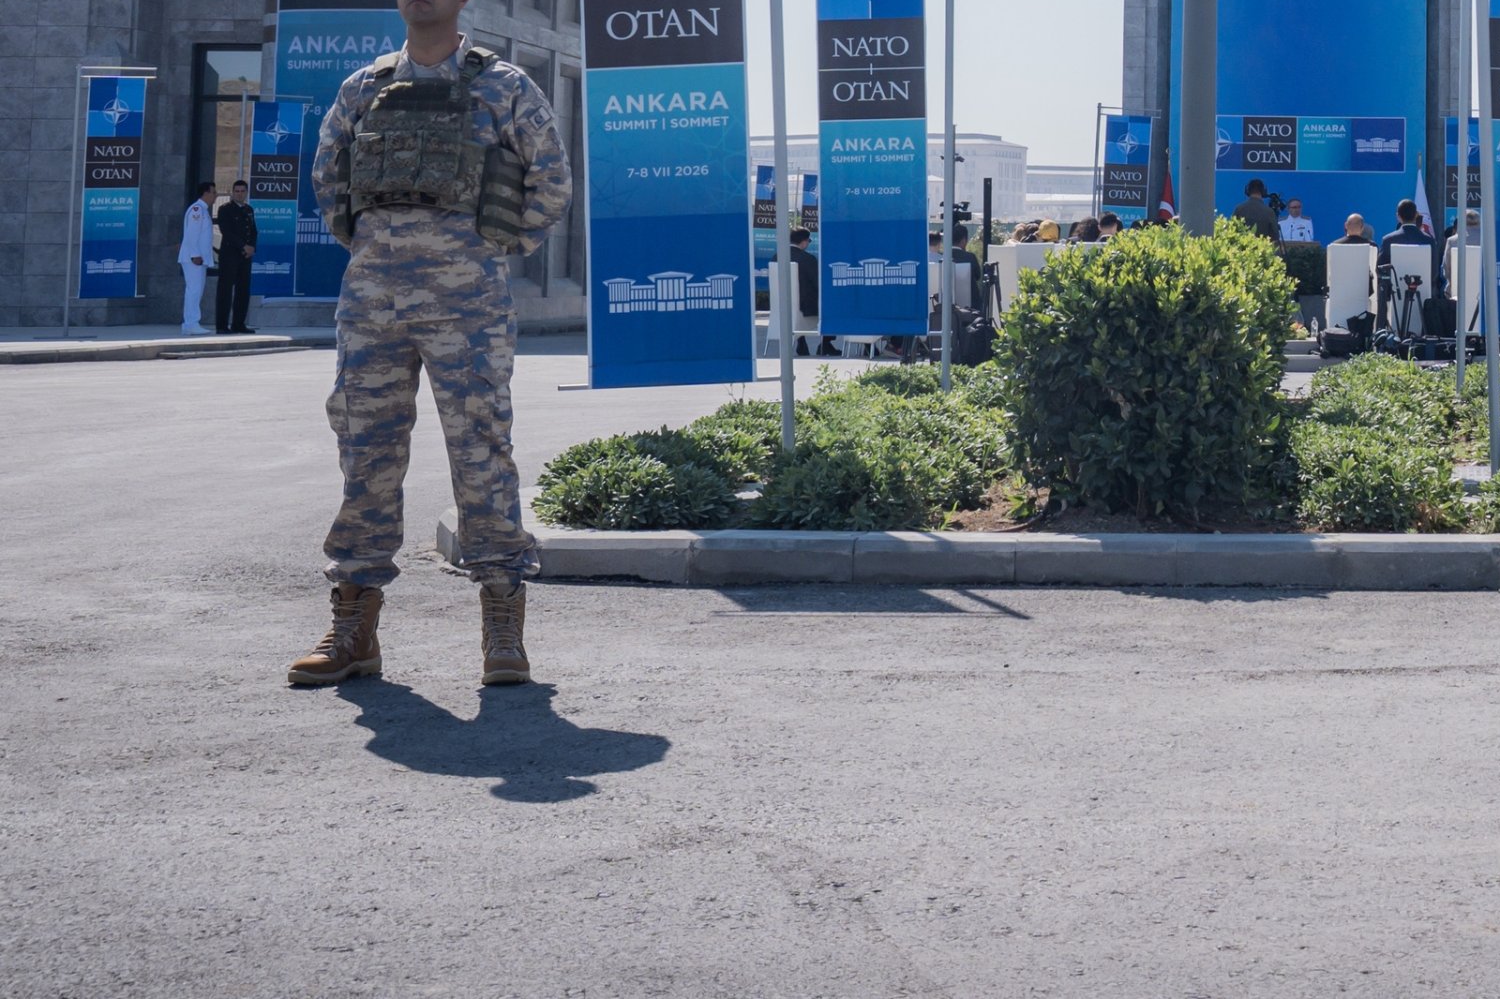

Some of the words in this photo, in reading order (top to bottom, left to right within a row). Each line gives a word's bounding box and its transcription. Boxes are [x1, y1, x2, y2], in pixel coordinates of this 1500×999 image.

[606, 7, 721, 41] OTAN
[288, 35, 395, 54] ANKARA
[832, 36, 909, 57] NATO
[287, 60, 333, 69] SUMMIT
[833, 81, 910, 102] OTAN
[604, 91, 729, 115] ANKARA
[604, 119, 658, 131] SUMMIT
[670, 116, 729, 128] SOMMET
[1303, 124, 1346, 132] ANKARA
[1247, 123, 1292, 137] NATO
[831, 137, 915, 152] ANKARA
[94, 146, 134, 157] NATO
[1246, 150, 1292, 163] OTAN
[831, 155, 867, 163] SUMMIT
[874, 154, 915, 162] SOMMET
[258, 162, 293, 173] NATO
[627, 168, 648, 178] 7-8
[653, 167, 670, 177] VII
[675, 165, 709, 176] 2026
[92, 168, 133, 179] OTAN
[1110, 171, 1142, 181] NATO
[256, 182, 292, 192] OTAN
[845, 187, 860, 195] 7-8
[862, 187, 875, 195] VII
[877, 186, 901, 195] 2026
[1108, 189, 1141, 200] OTAN
[89, 197, 134, 205] ANKARA
